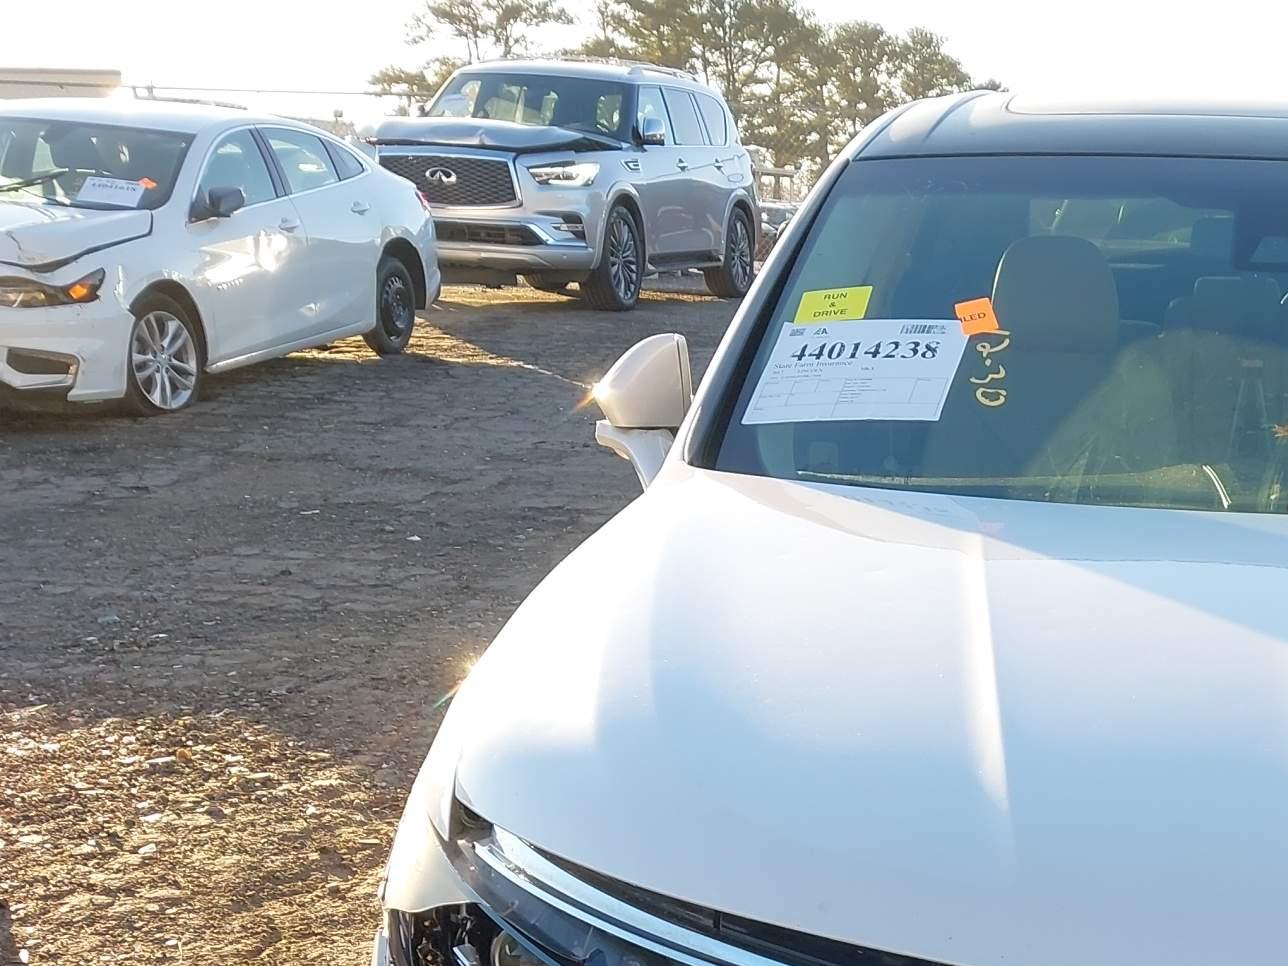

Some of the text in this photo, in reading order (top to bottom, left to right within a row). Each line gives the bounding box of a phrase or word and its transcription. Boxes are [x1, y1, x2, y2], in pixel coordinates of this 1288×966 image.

[823, 292, 848, 301] RUN
[812, 308, 849, 318] DRIVE
[791, 340, 941, 362] 44014238
[773, 362, 793, 370] State
[794, 361, 814, 369] Farm
